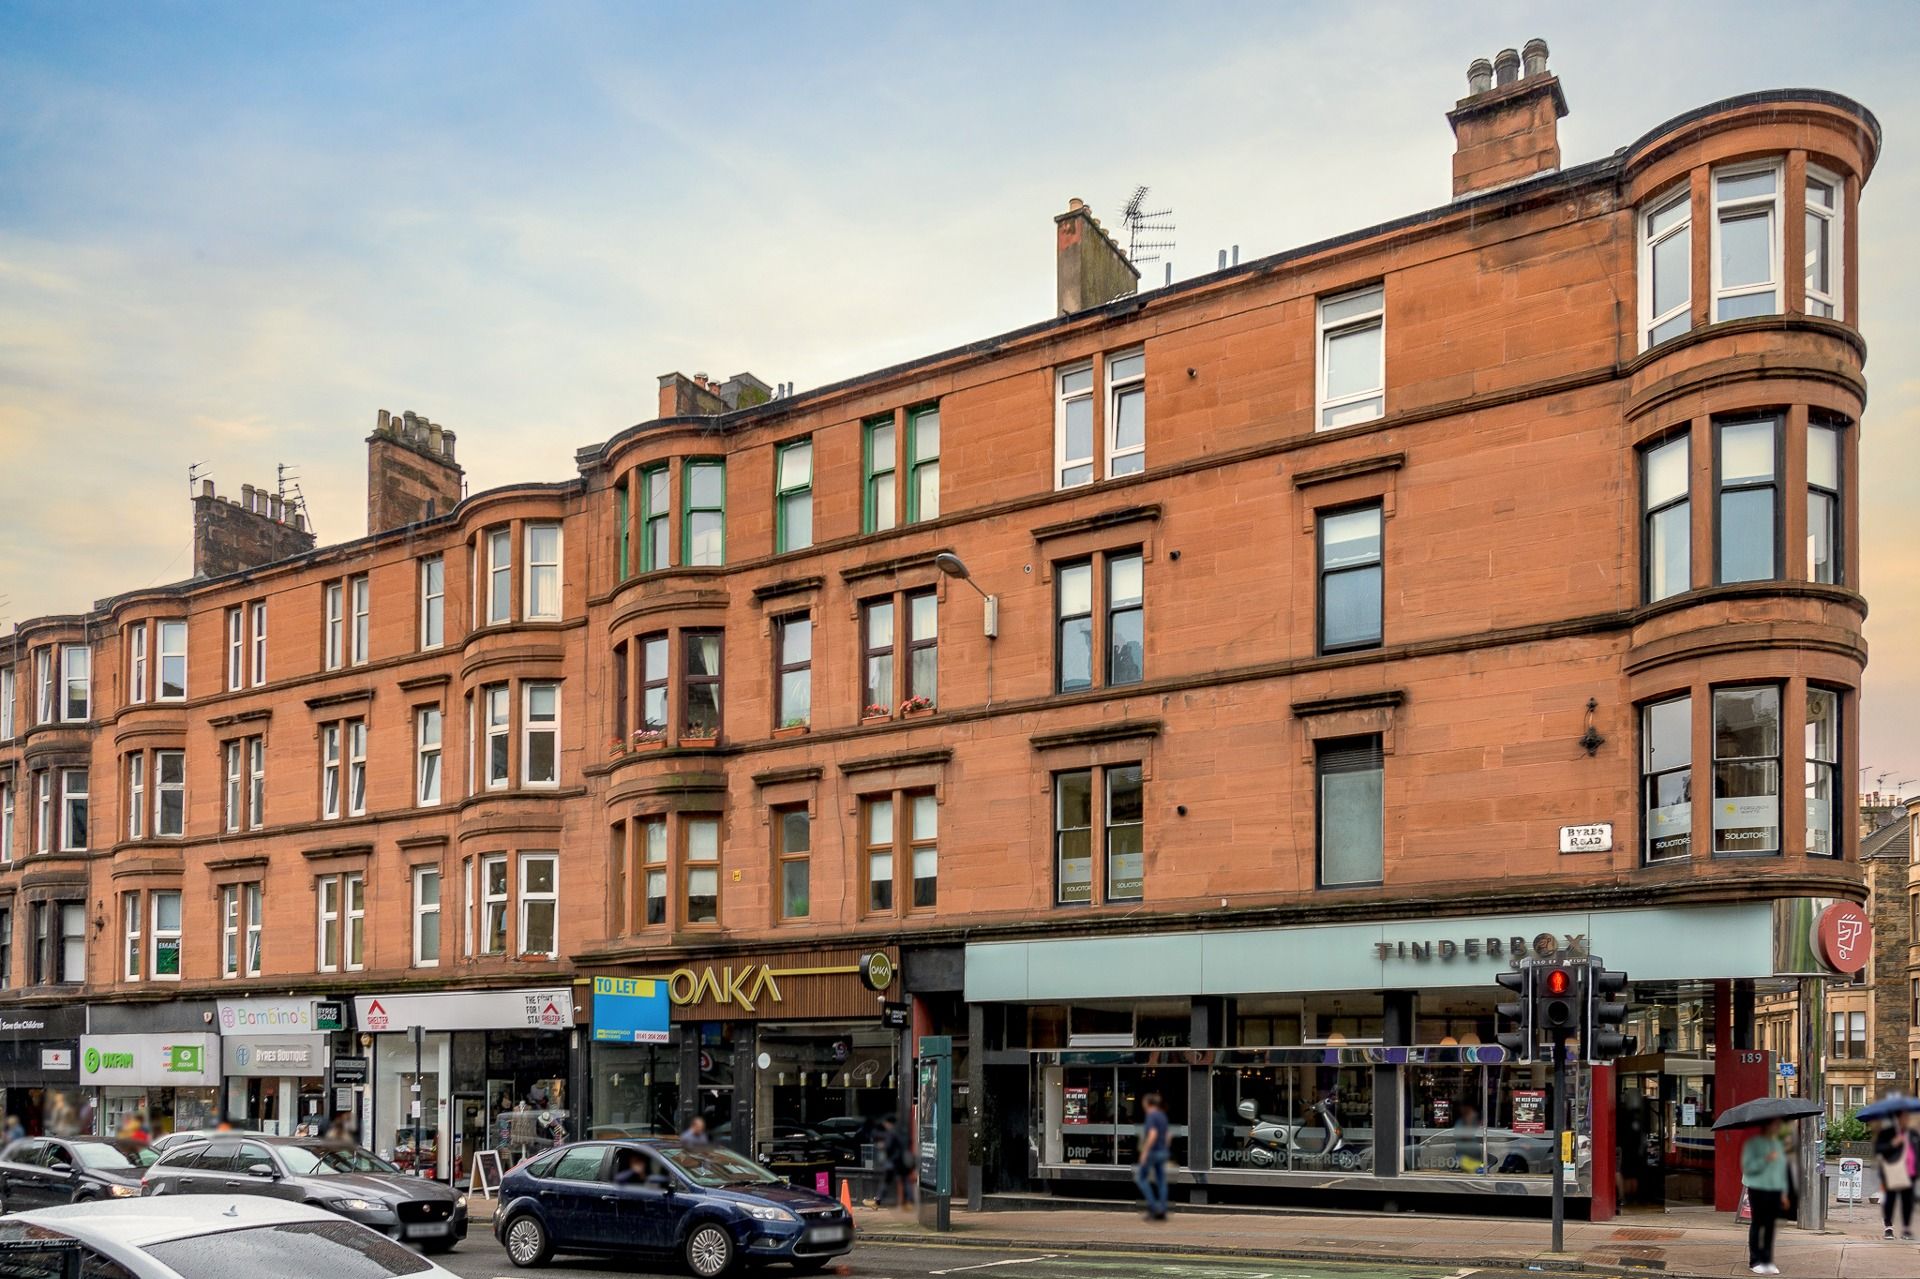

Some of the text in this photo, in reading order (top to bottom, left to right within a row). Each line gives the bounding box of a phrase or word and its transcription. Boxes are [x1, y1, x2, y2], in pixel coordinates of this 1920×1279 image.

[1567, 828, 1604, 837] BYRES
[1725, 831, 1770, 840] SOLICITORS
[1570, 837, 1601, 846] ROAD
[1656, 837, 1692, 849] SOLICITORS
[1117, 881, 1143, 889] SOLICITOR
[871, 966, 889, 976] OAKA
[597, 978, 638, 994] TO LET
[669, 964, 782, 1012] OAKA
[238, 1006, 308, 1025] Bambino's
[367, 1016, 389, 1025] SHELTER
[541, 1014, 560, 1022] SHELTER
[102, 1053, 134, 1069] OXFAM
[256, 1049, 310, 1063] BYRES BOUTIQUE
[1741, 1053, 1763, 1064] 189
[1067, 1146, 1092, 1158] DRIP
